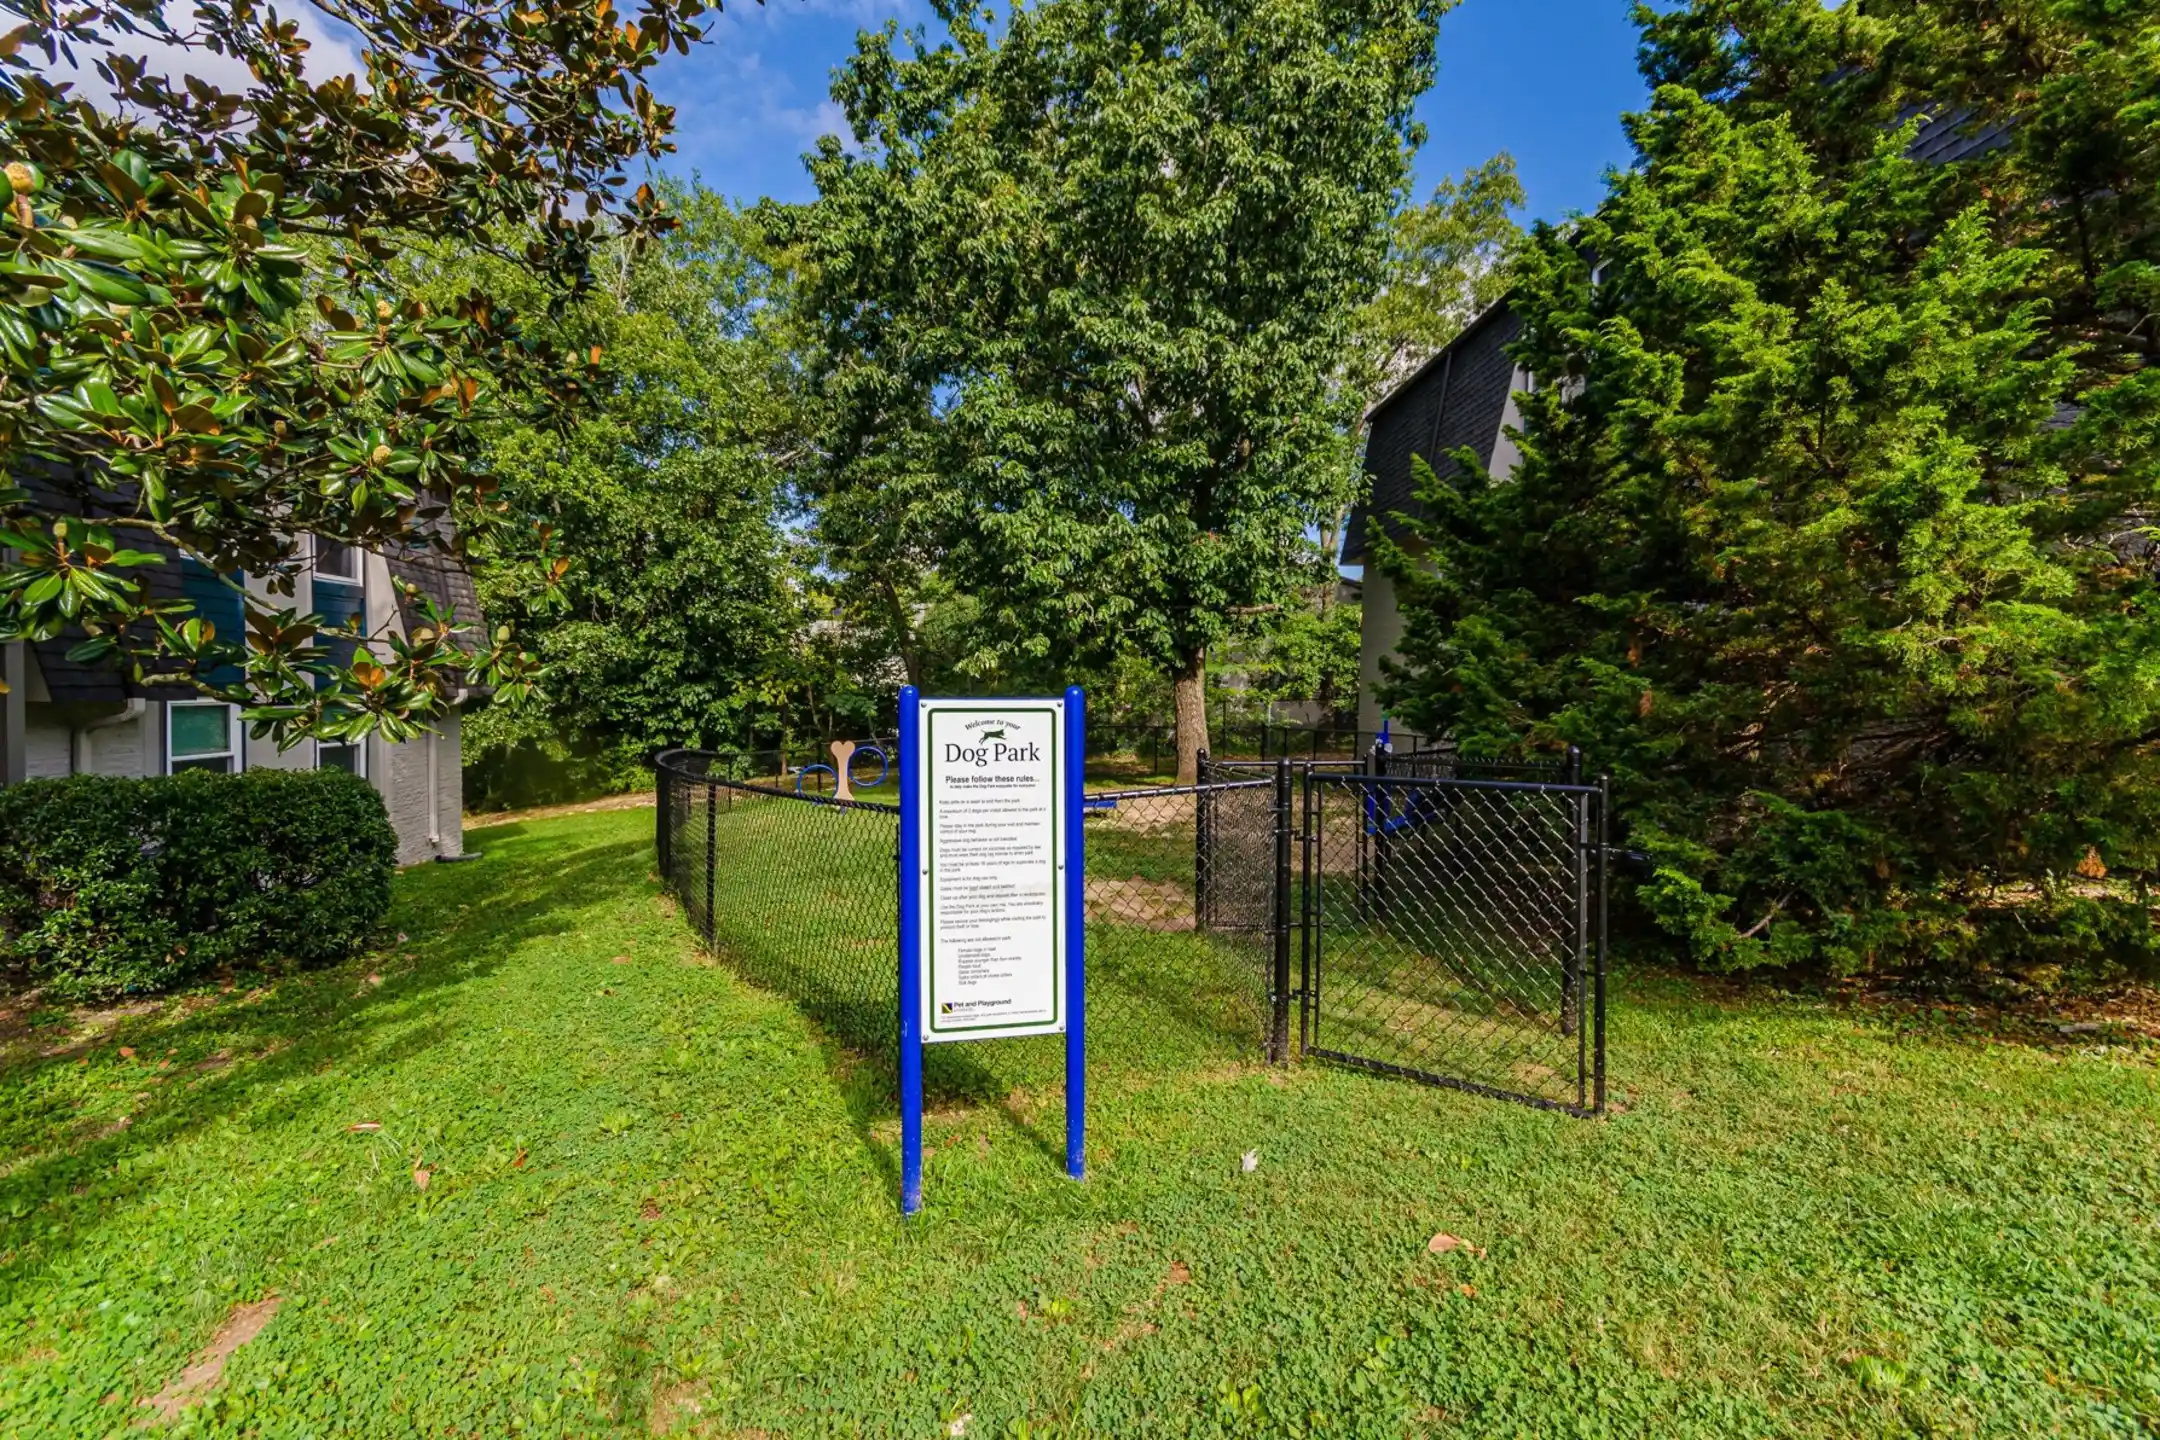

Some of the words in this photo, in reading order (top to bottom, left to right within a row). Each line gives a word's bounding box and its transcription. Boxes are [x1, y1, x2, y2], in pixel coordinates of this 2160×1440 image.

[965, 719, 995, 730] Welcome
[1004, 720, 1021, 730] your
[944, 743, 989, 767] Dog
[994, 741, 1041, 762] Park
[945, 775, 969, 784] Please
[971, 775, 993, 783] follow
[994, 774, 1015, 783] these
[978, 999, 1012, 1008] Playground
